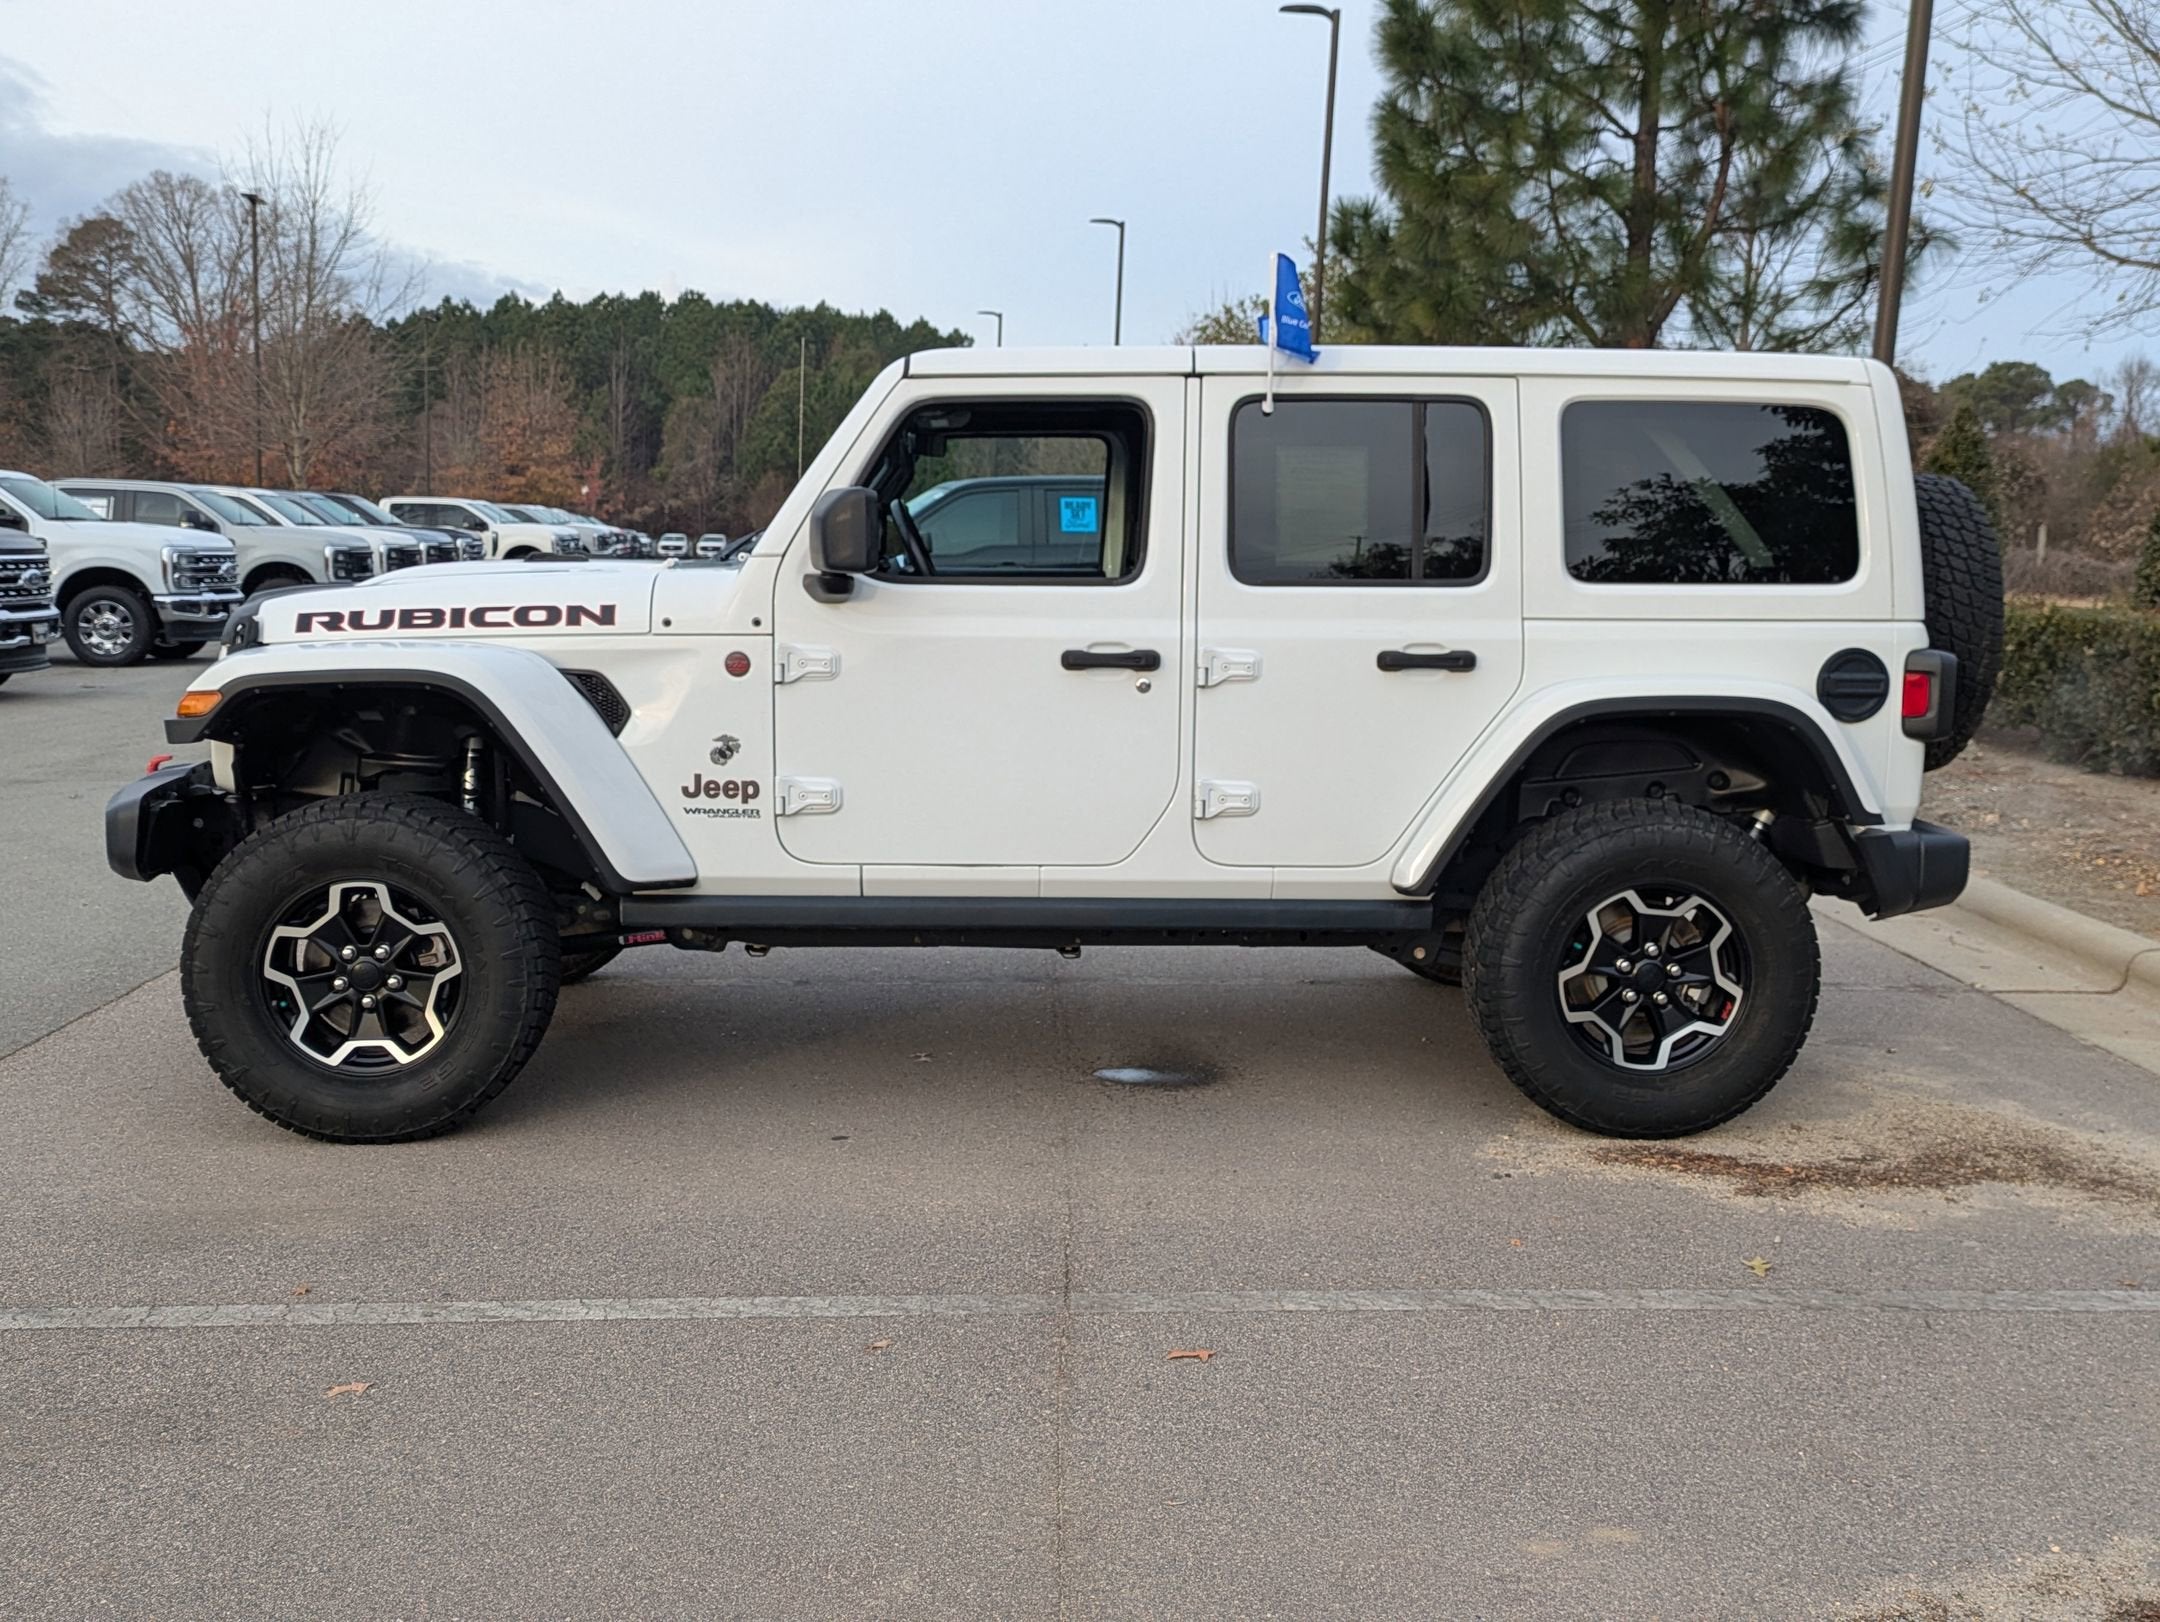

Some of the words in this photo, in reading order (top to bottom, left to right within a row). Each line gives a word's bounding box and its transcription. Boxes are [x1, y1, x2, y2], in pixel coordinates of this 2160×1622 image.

[1281, 314, 1298, 326] Blue
[295, 604, 616, 633] RUBICON
[681, 773, 760, 804] Jeep
[683, 807, 760, 815] WRANGLER
